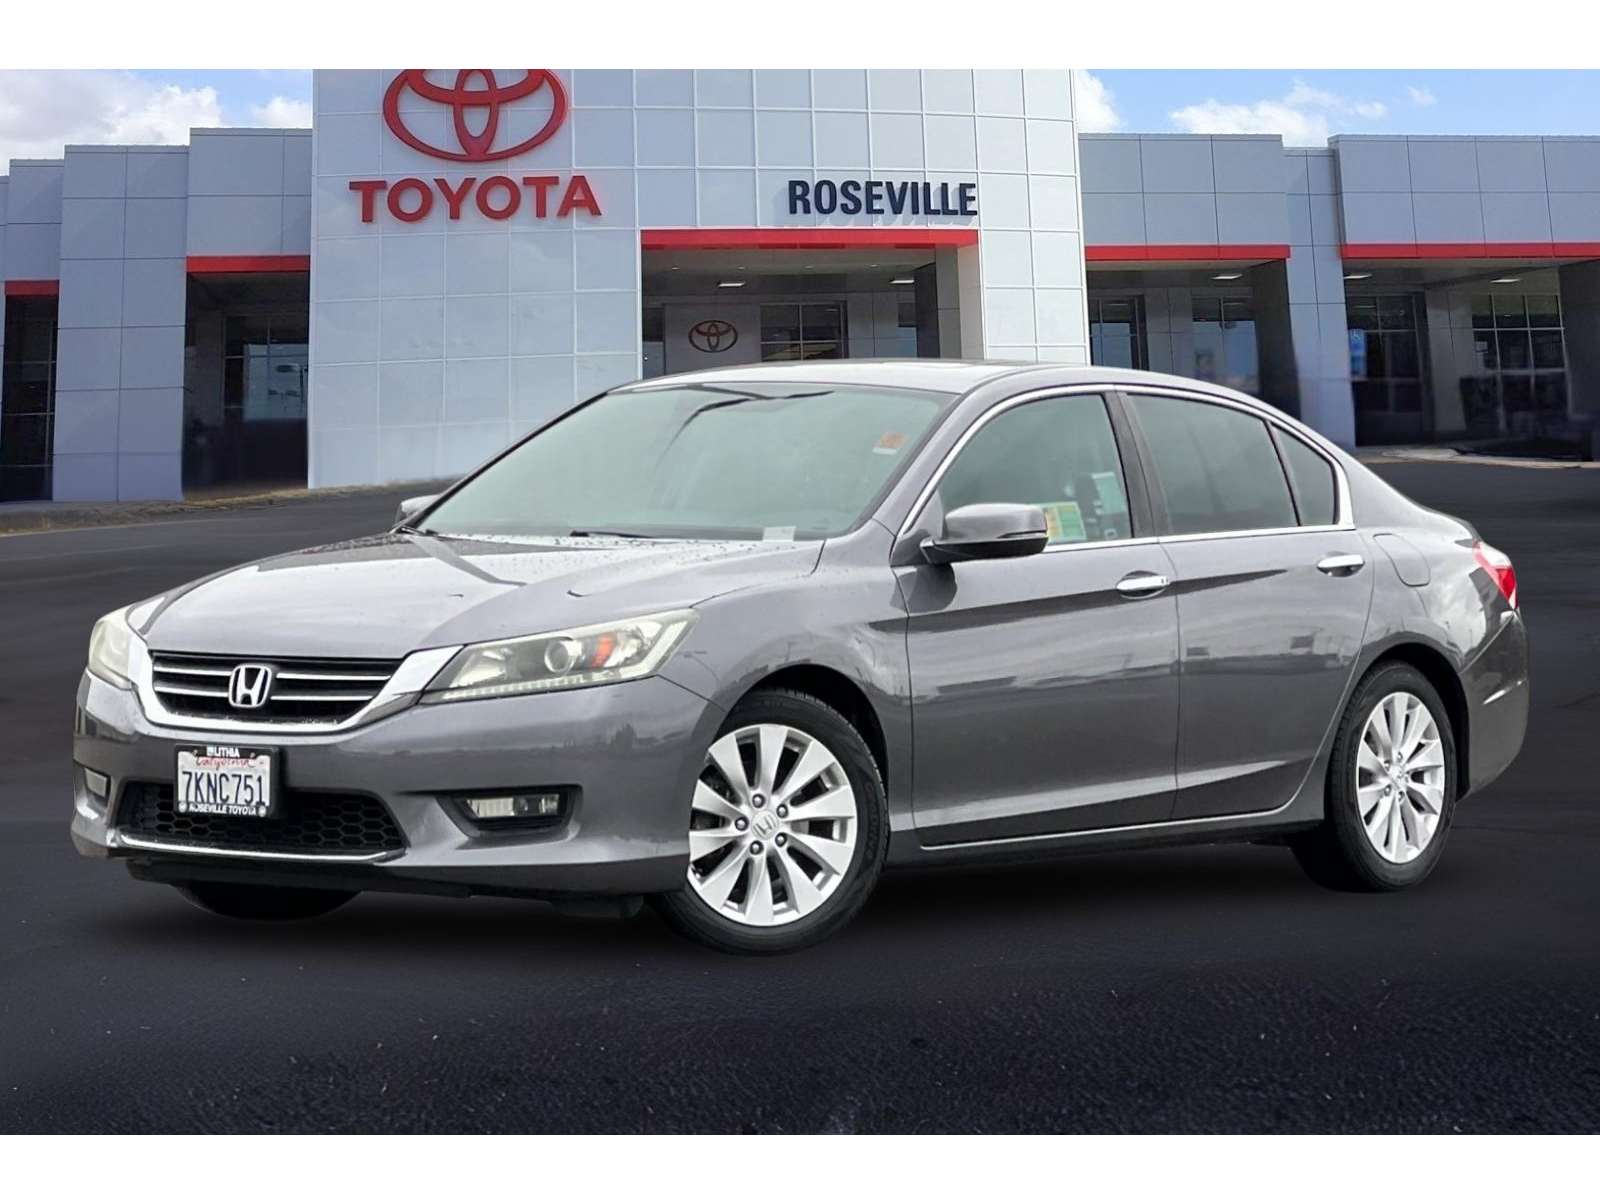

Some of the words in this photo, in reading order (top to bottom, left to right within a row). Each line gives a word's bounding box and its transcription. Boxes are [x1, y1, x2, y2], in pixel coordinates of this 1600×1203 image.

[348, 175, 602, 223] TOYOTA
[788, 180, 978, 217] ROSEVILLE
[182, 771, 265, 805] 7KNC751
